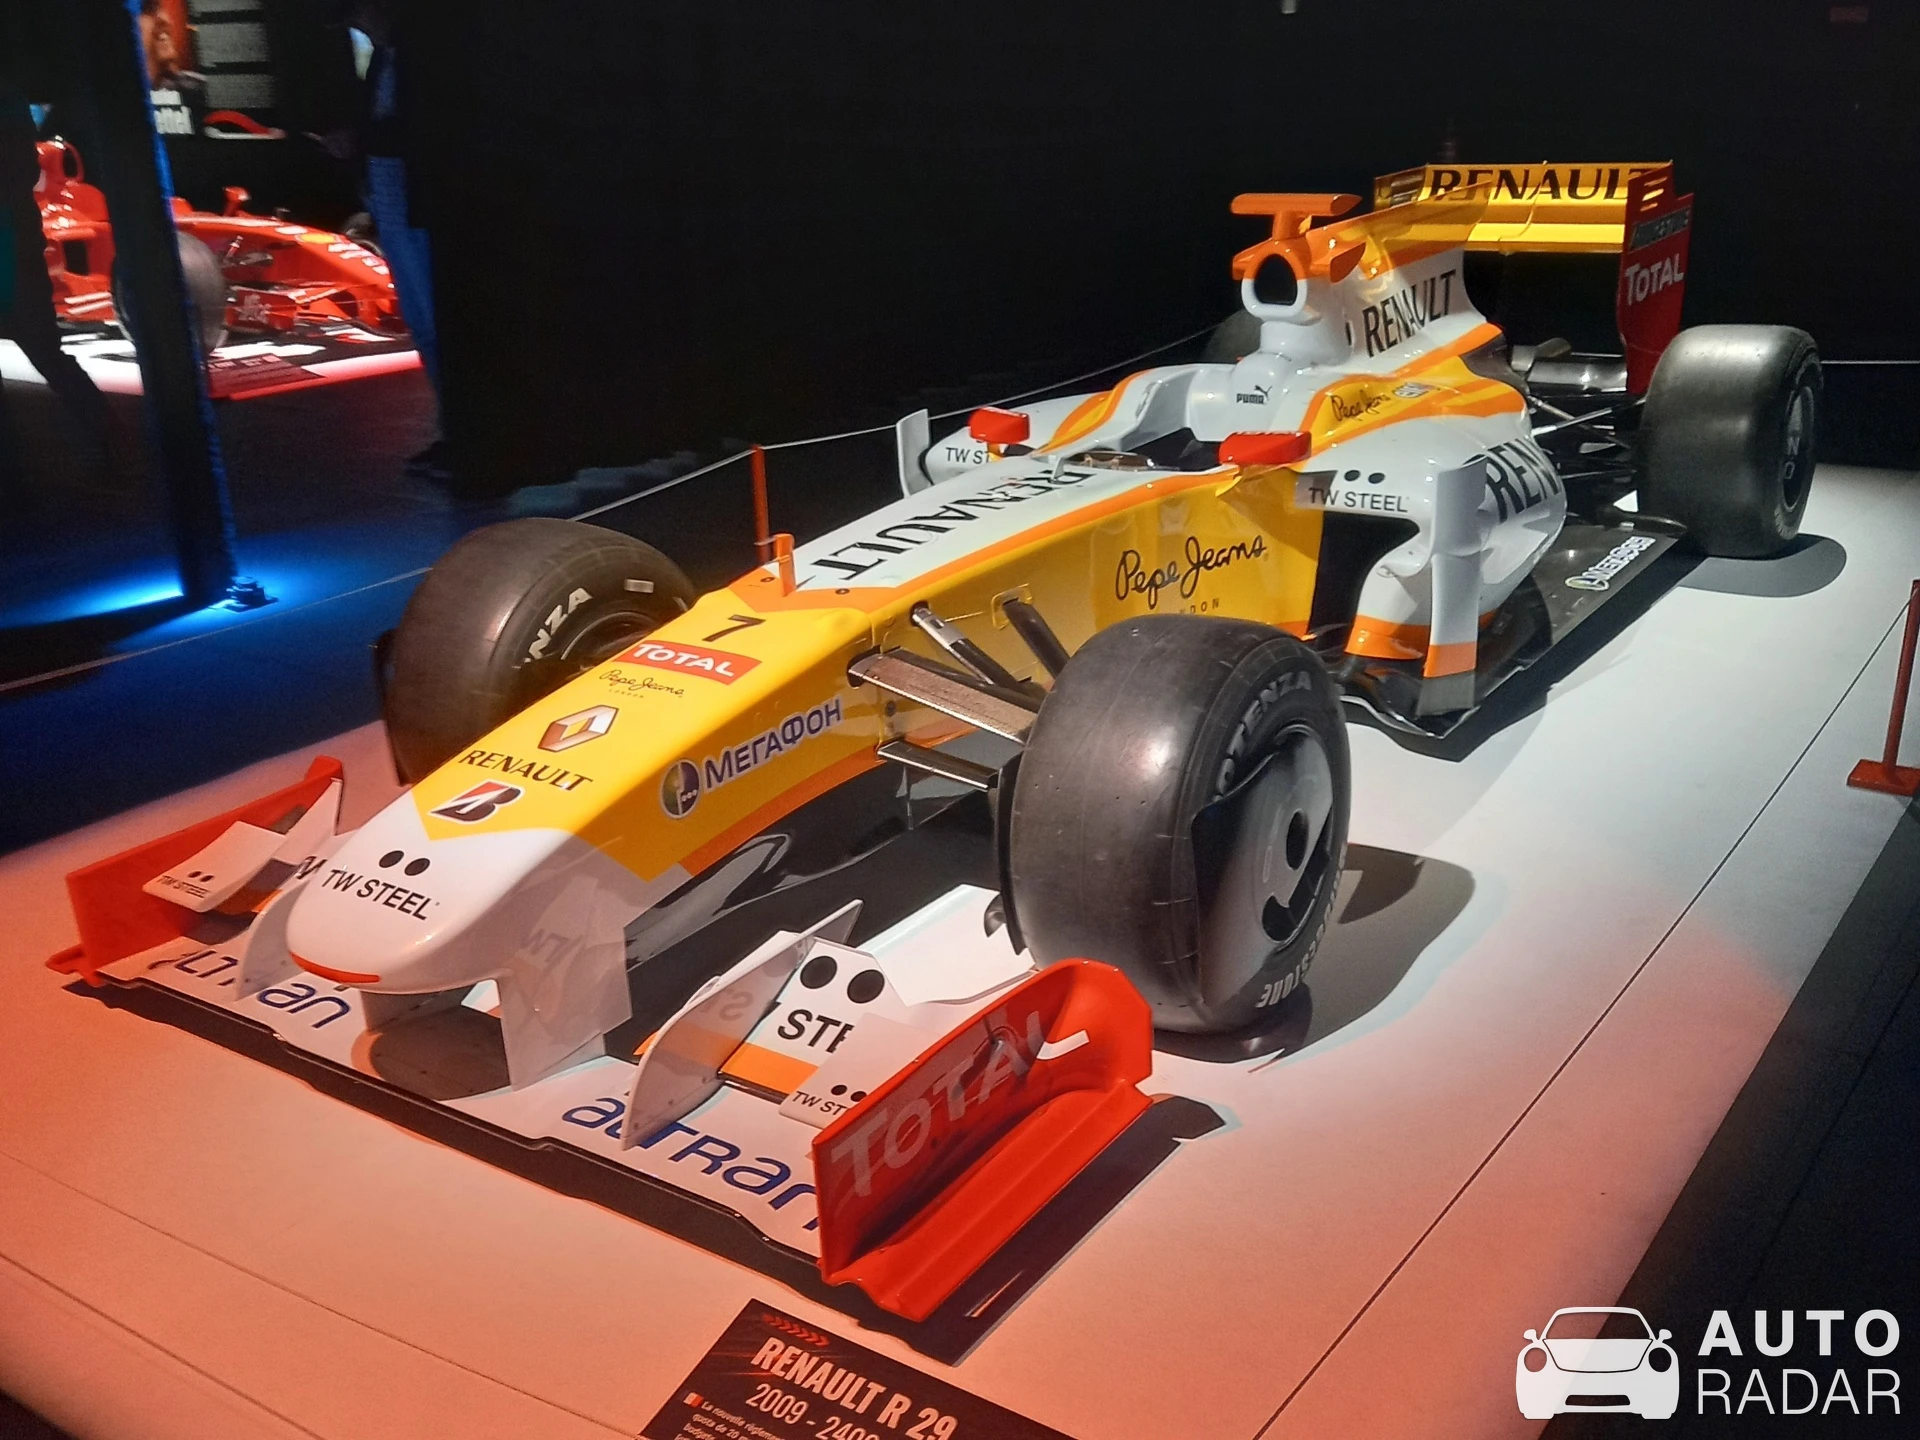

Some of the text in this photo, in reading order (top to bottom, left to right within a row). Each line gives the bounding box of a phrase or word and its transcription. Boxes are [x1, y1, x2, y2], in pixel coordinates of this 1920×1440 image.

[1429, 168, 1658, 201] RENAUL
[1362, 269, 1456, 358] RENAULT
[1236, 393, 1264, 405] PUMA
[945, 447, 970, 463] TW
[1463, 439, 1561, 524] REN
[1308, 488, 1408, 513] TW STEEL
[810, 470, 1097, 580] RENAULT
[1116, 535, 1268, 610] Pepe Jeans
[702, 614, 766, 642] 7
[633, 643, 735, 677] TOTAL
[599, 669, 684, 696] Pepe Jeans
[458, 750, 594, 791] RENAULT
[321, 869, 432, 921] TW STEEL
[792, 1090, 821, 1108] TW
[745, 1383, 810, 1425] 2009
[751, 1336, 959, 1440] RENAULT R 29
